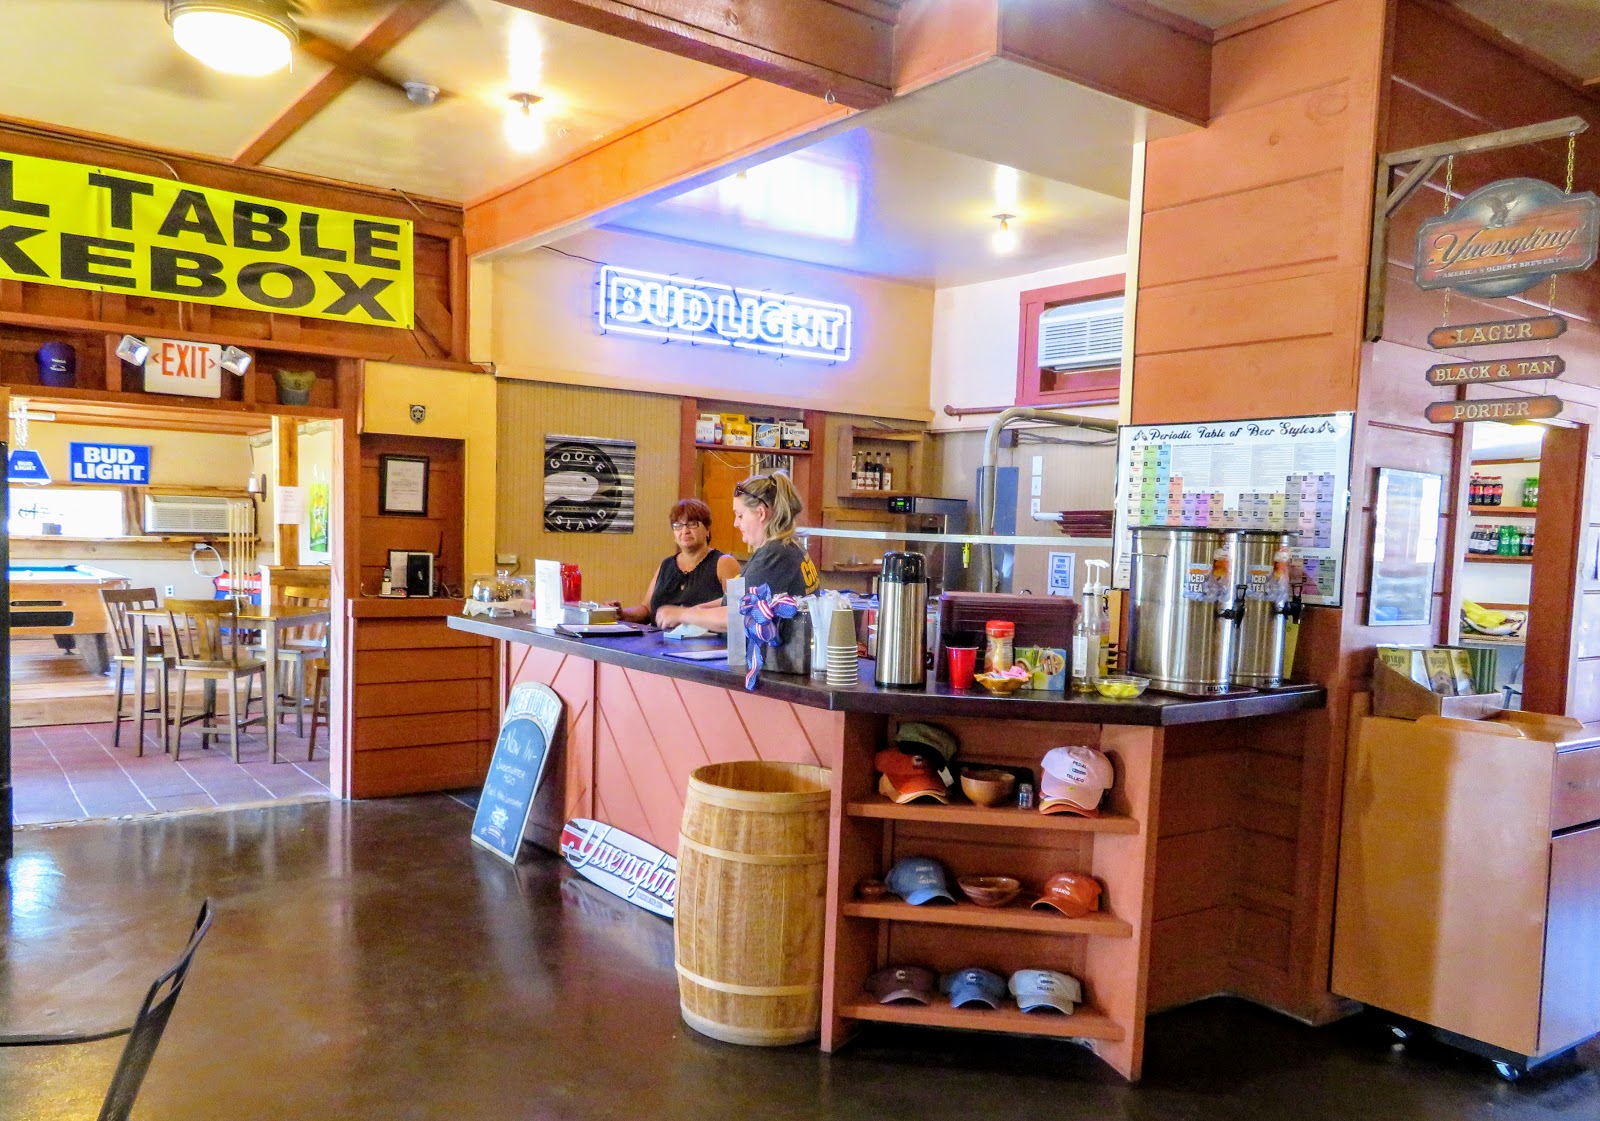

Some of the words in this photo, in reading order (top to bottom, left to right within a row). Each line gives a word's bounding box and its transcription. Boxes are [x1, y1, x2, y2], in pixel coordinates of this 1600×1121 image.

[88, 172, 401, 271] TABLE
[1428, 224, 1586, 273] Yuengling
[1486, 262, 1518, 273] OLDEST
[610, 276, 714, 331] BUD
[717, 294, 844, 350] LIGHT
[1455, 322, 1533, 344] LAGER
[161, 342, 210, 380] EXIT
[1434, 365, 1491, 382] BLACK
[1497, 364, 1511, 377] &
[1517, 360, 1556, 375] TAN
[1452, 402, 1531, 420] PORTER
[1149, 428, 1193, 441] Periodic
[1197, 425, 1226, 439] Table
[1229, 427, 1243, 438] of
[1247, 423, 1276, 437] Beer
[1278, 420, 1317, 438] Styles
[83, 446, 136, 465] BUD
[550, 451, 606, 473] GOOSE
[73, 462, 145, 481] LIGHT
[547, 509, 607, 531] ISLAND
[1188, 573, 1205, 583] ICED
[1189, 583, 1203, 593] TEA
[1251, 574, 1267, 584] ICED
[1252, 583, 1265, 592] TEA
[566, 820, 676, 902] Yuenglin
